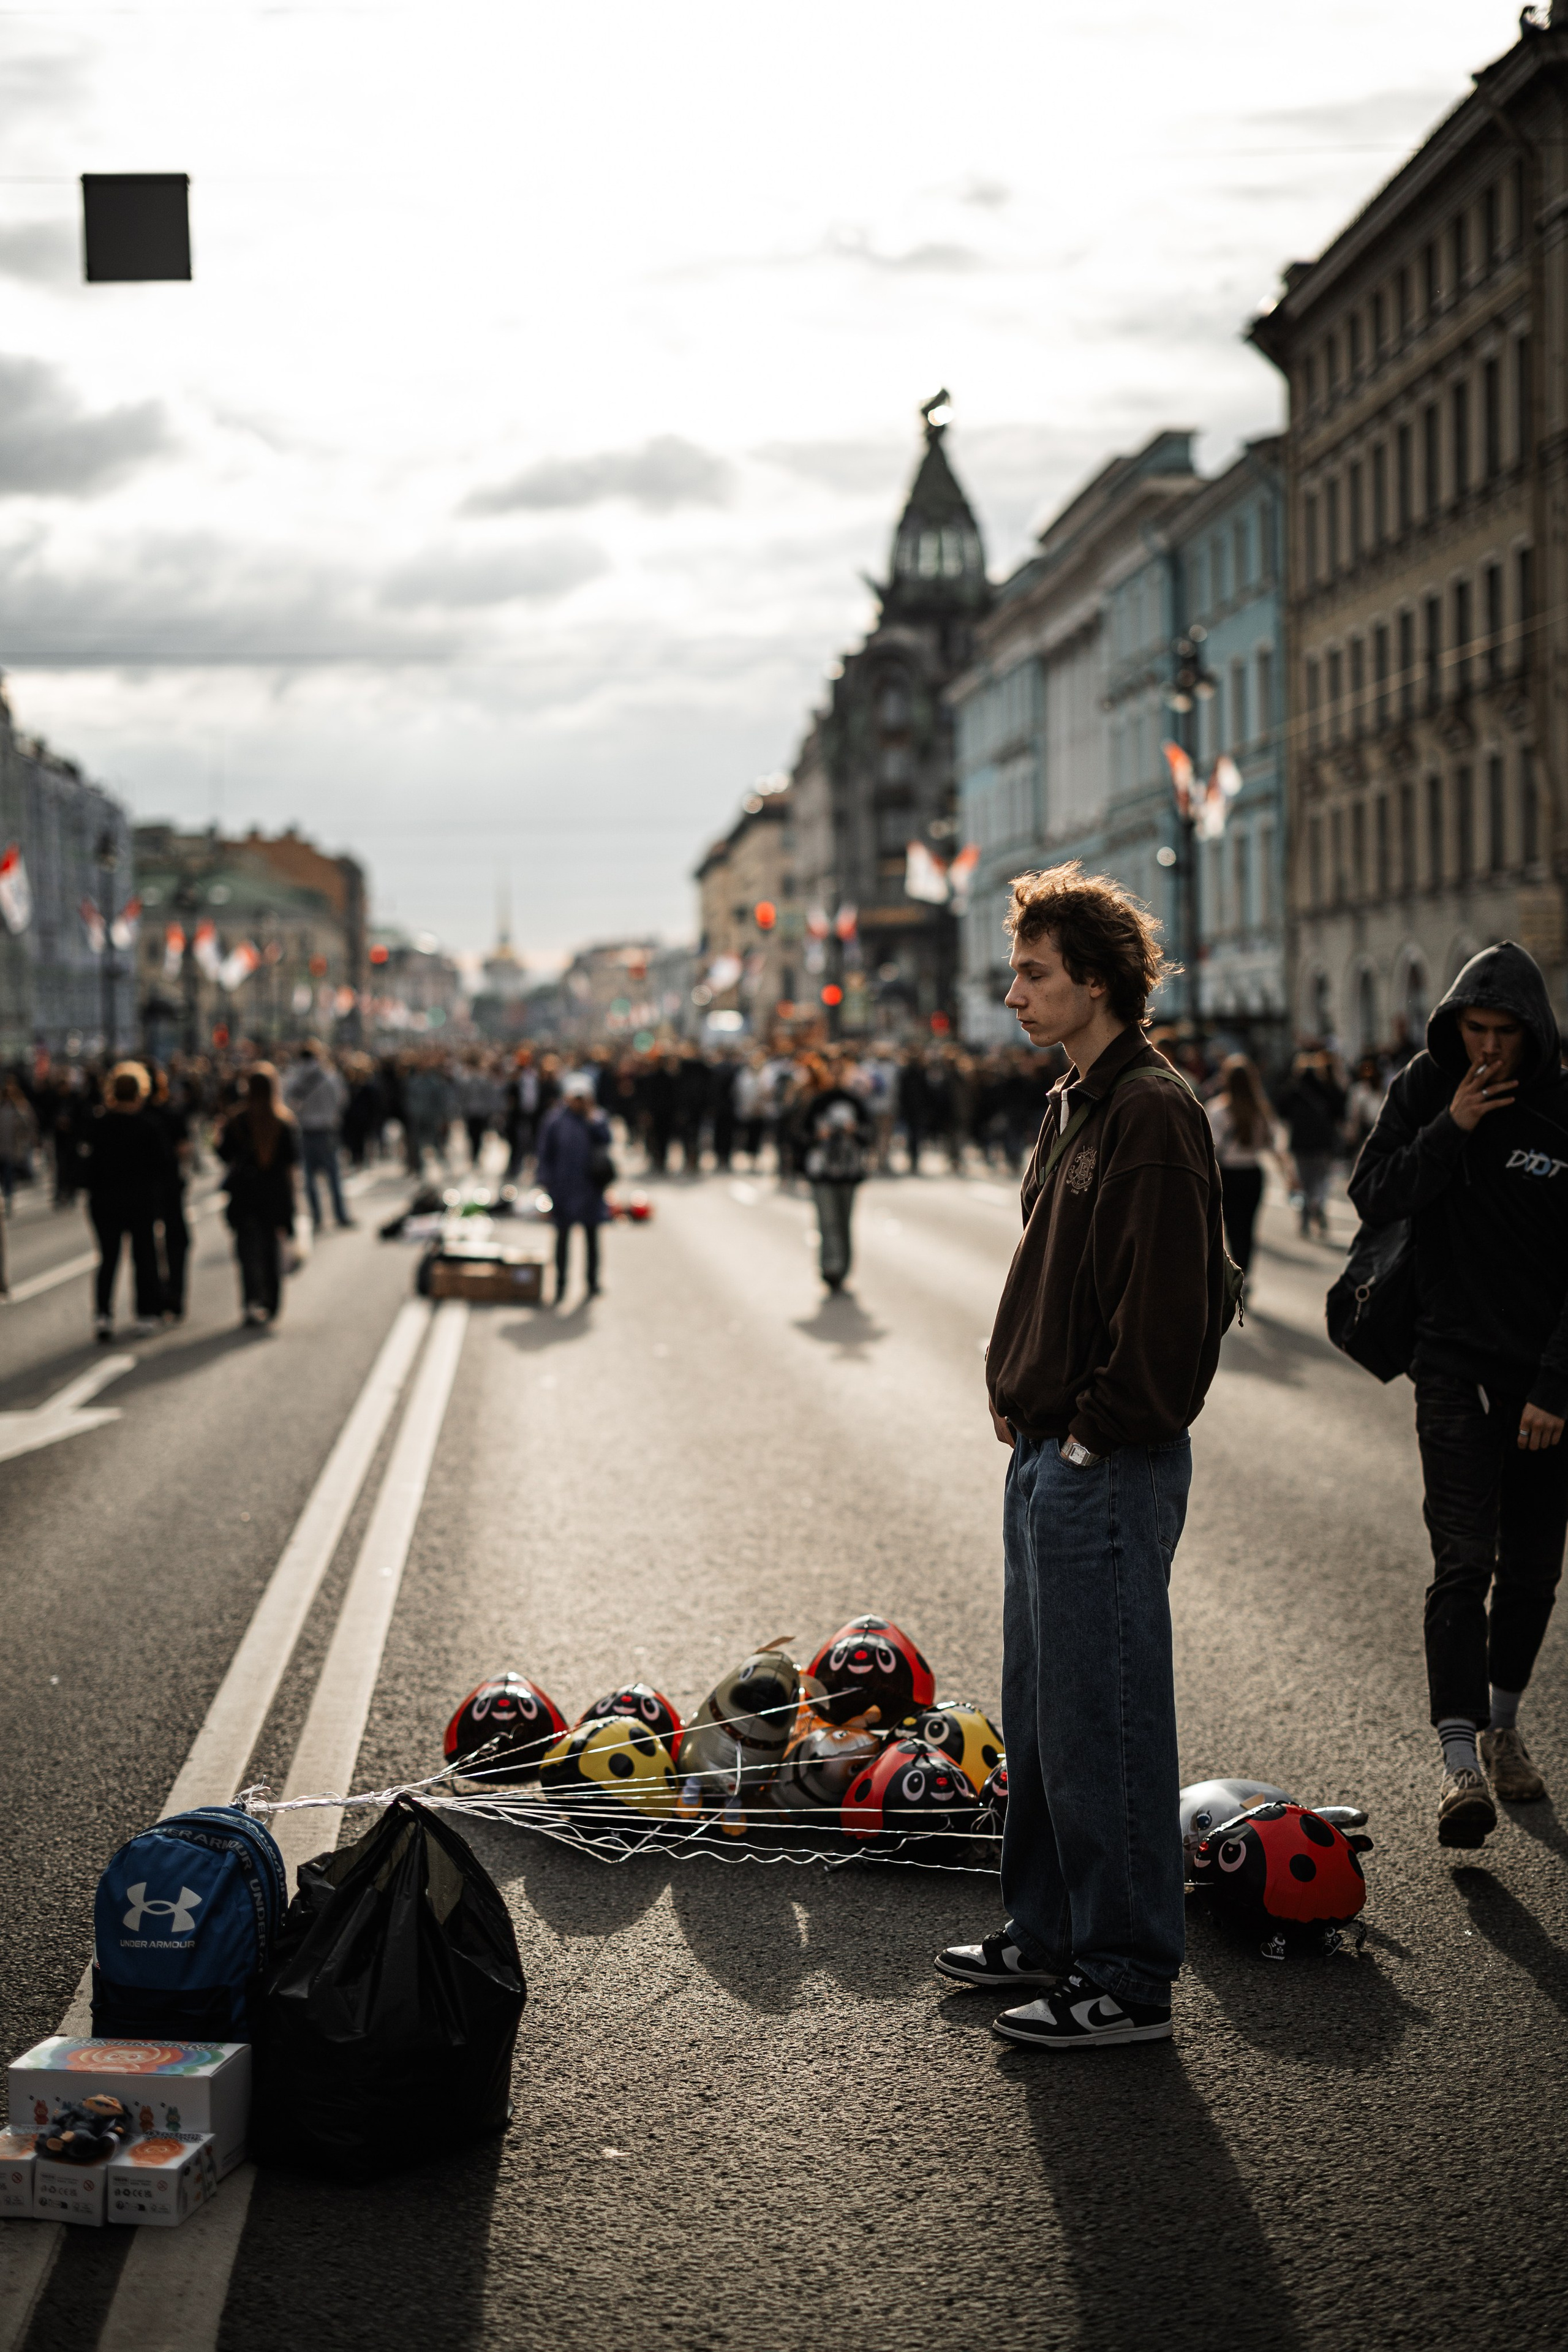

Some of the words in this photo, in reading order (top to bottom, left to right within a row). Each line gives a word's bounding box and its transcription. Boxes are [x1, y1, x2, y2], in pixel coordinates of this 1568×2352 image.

[194, 1833, 252, 1871] ARMOUR
[249, 1879, 267, 1949] UNDER
[119, 1939, 148, 1948] UNDER
[148, 1940, 195, 1949] ARMOUR
